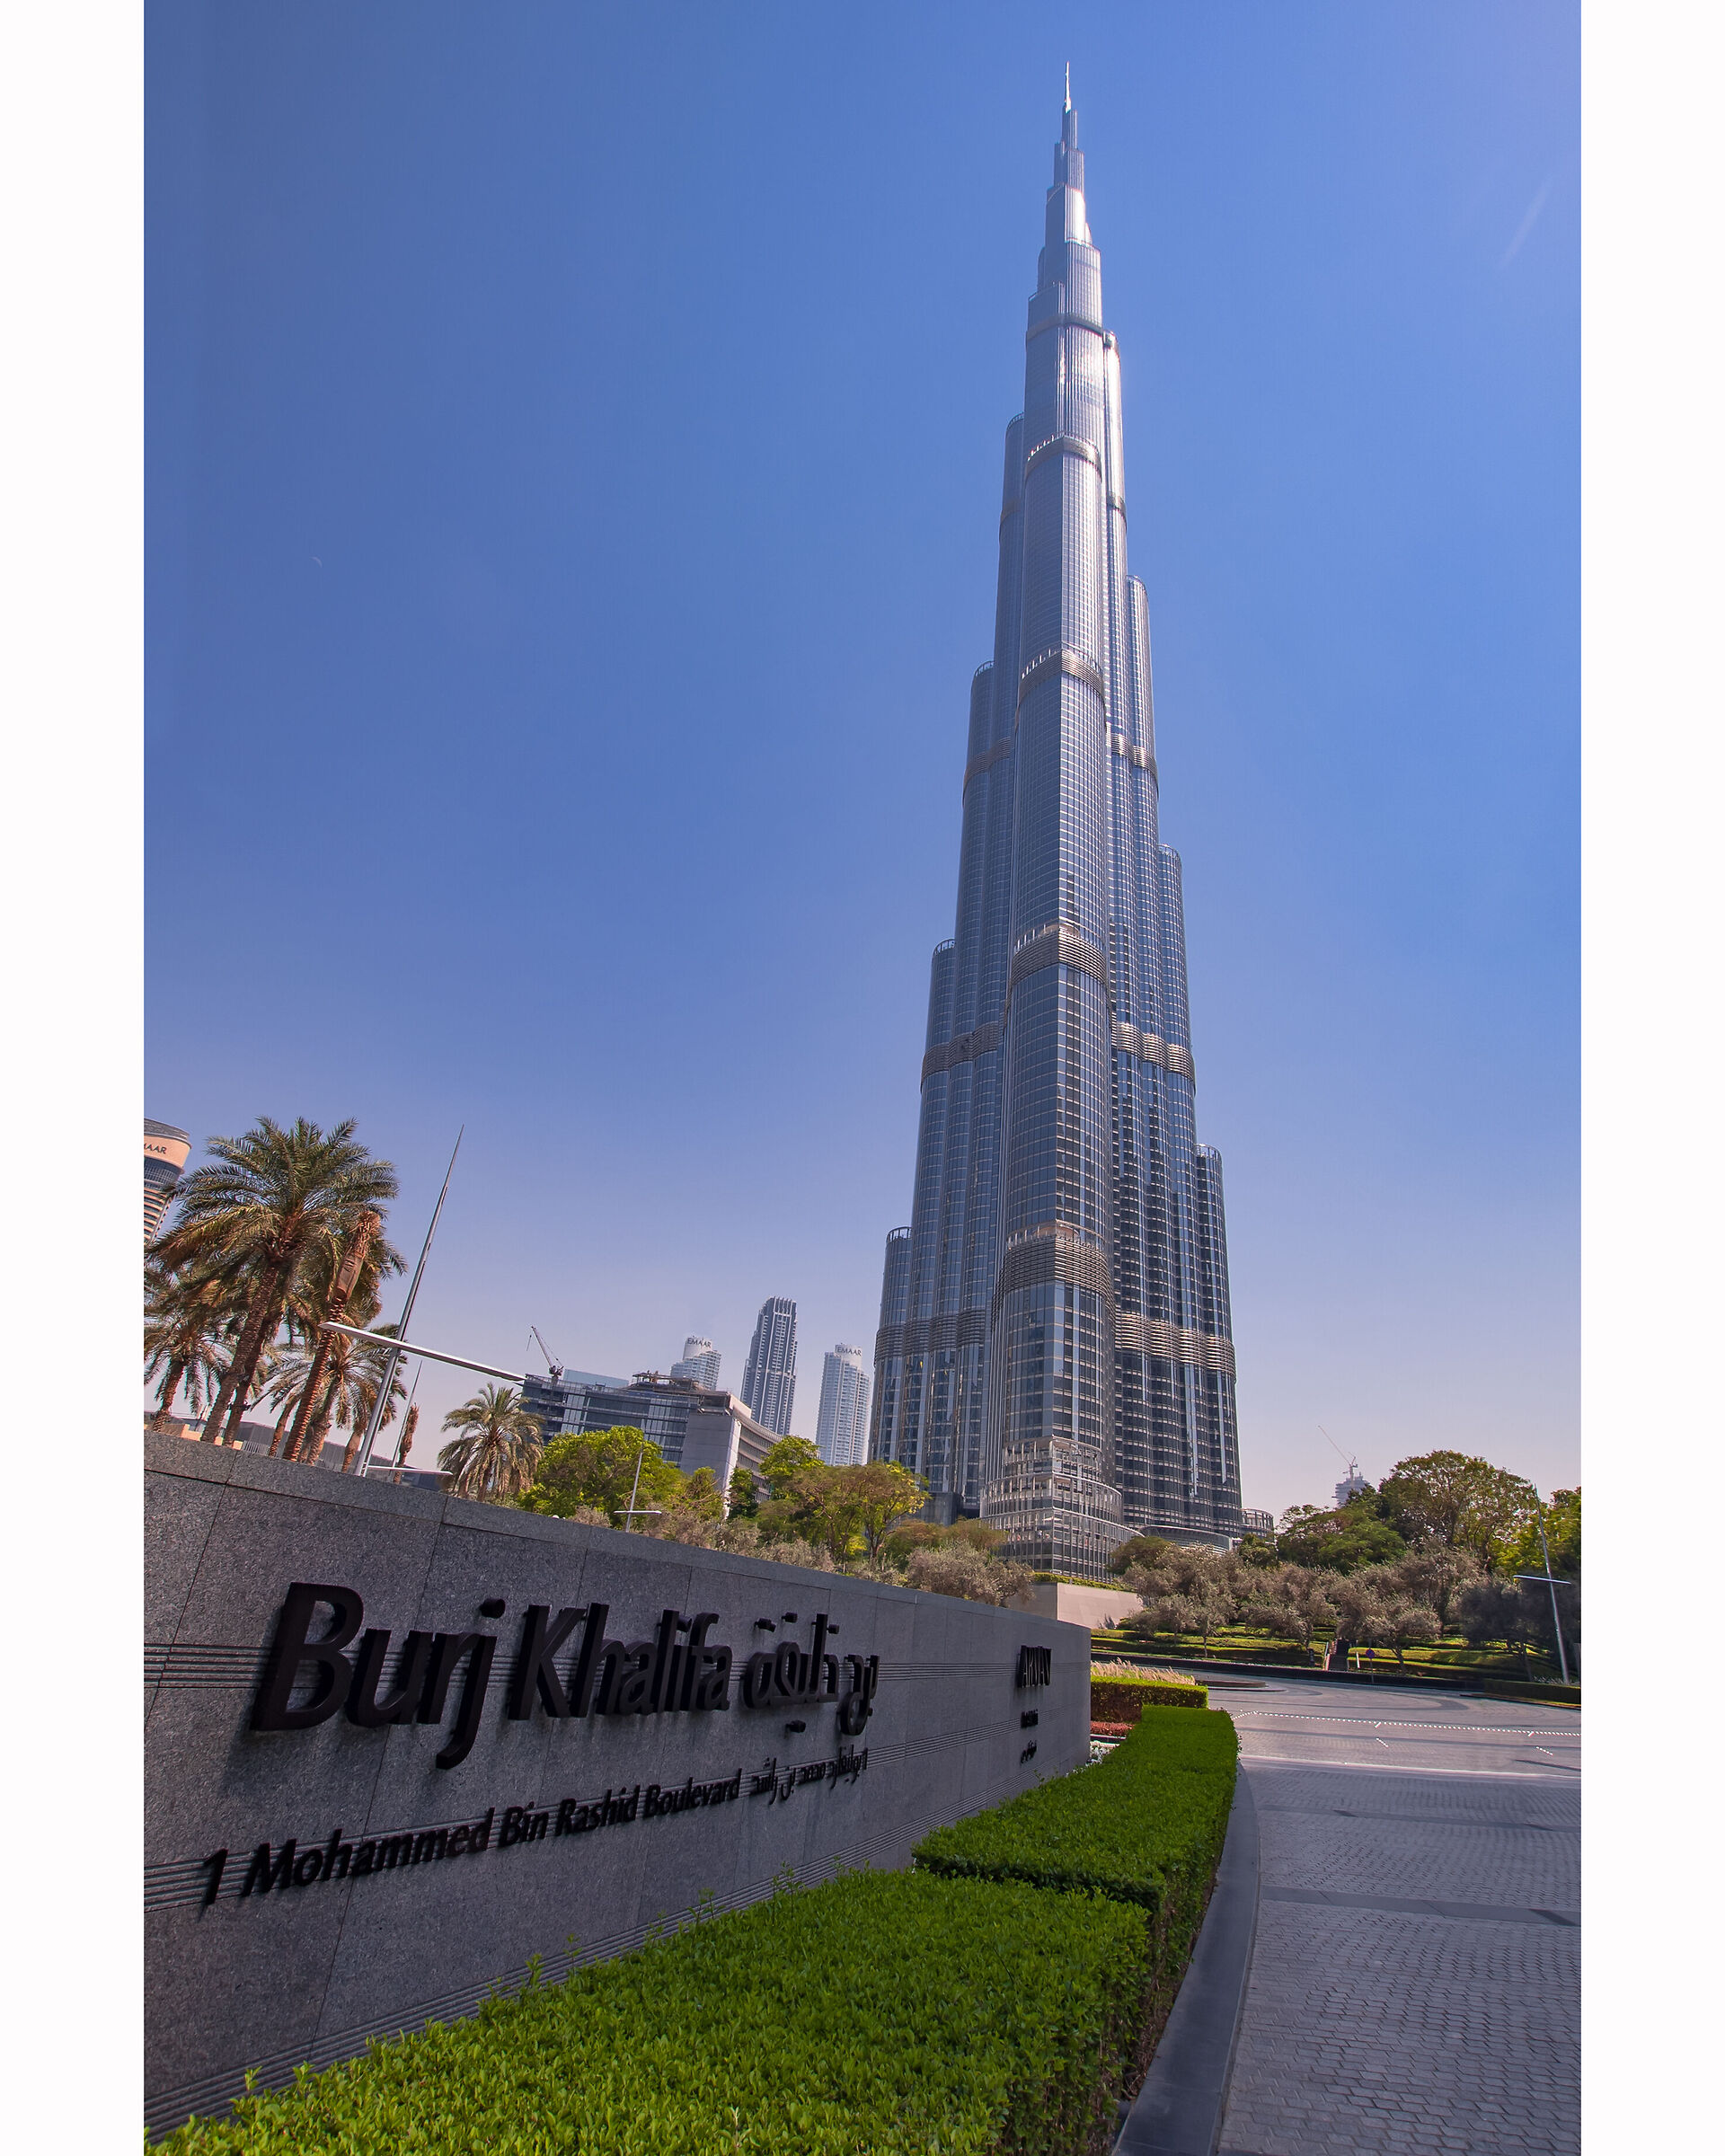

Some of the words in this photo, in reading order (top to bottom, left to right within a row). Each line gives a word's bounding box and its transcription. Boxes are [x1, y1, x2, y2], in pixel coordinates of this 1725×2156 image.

[686, 1338, 712, 1348] EMAAR
[836, 1346, 862, 1356] EMAAR
[250, 1582, 505, 1769] Burj
[507, 1603, 732, 1720] Khalifa
[743, 1612, 840, 1732] خليفة
[202, 1848, 229, 1905] 1
[240, 1807, 496, 1897] Mohammed
[497, 1801, 549, 1848] Bin
[553, 1785, 641, 1836] Rashid
[642, 1768, 742, 1820] Boulevard
